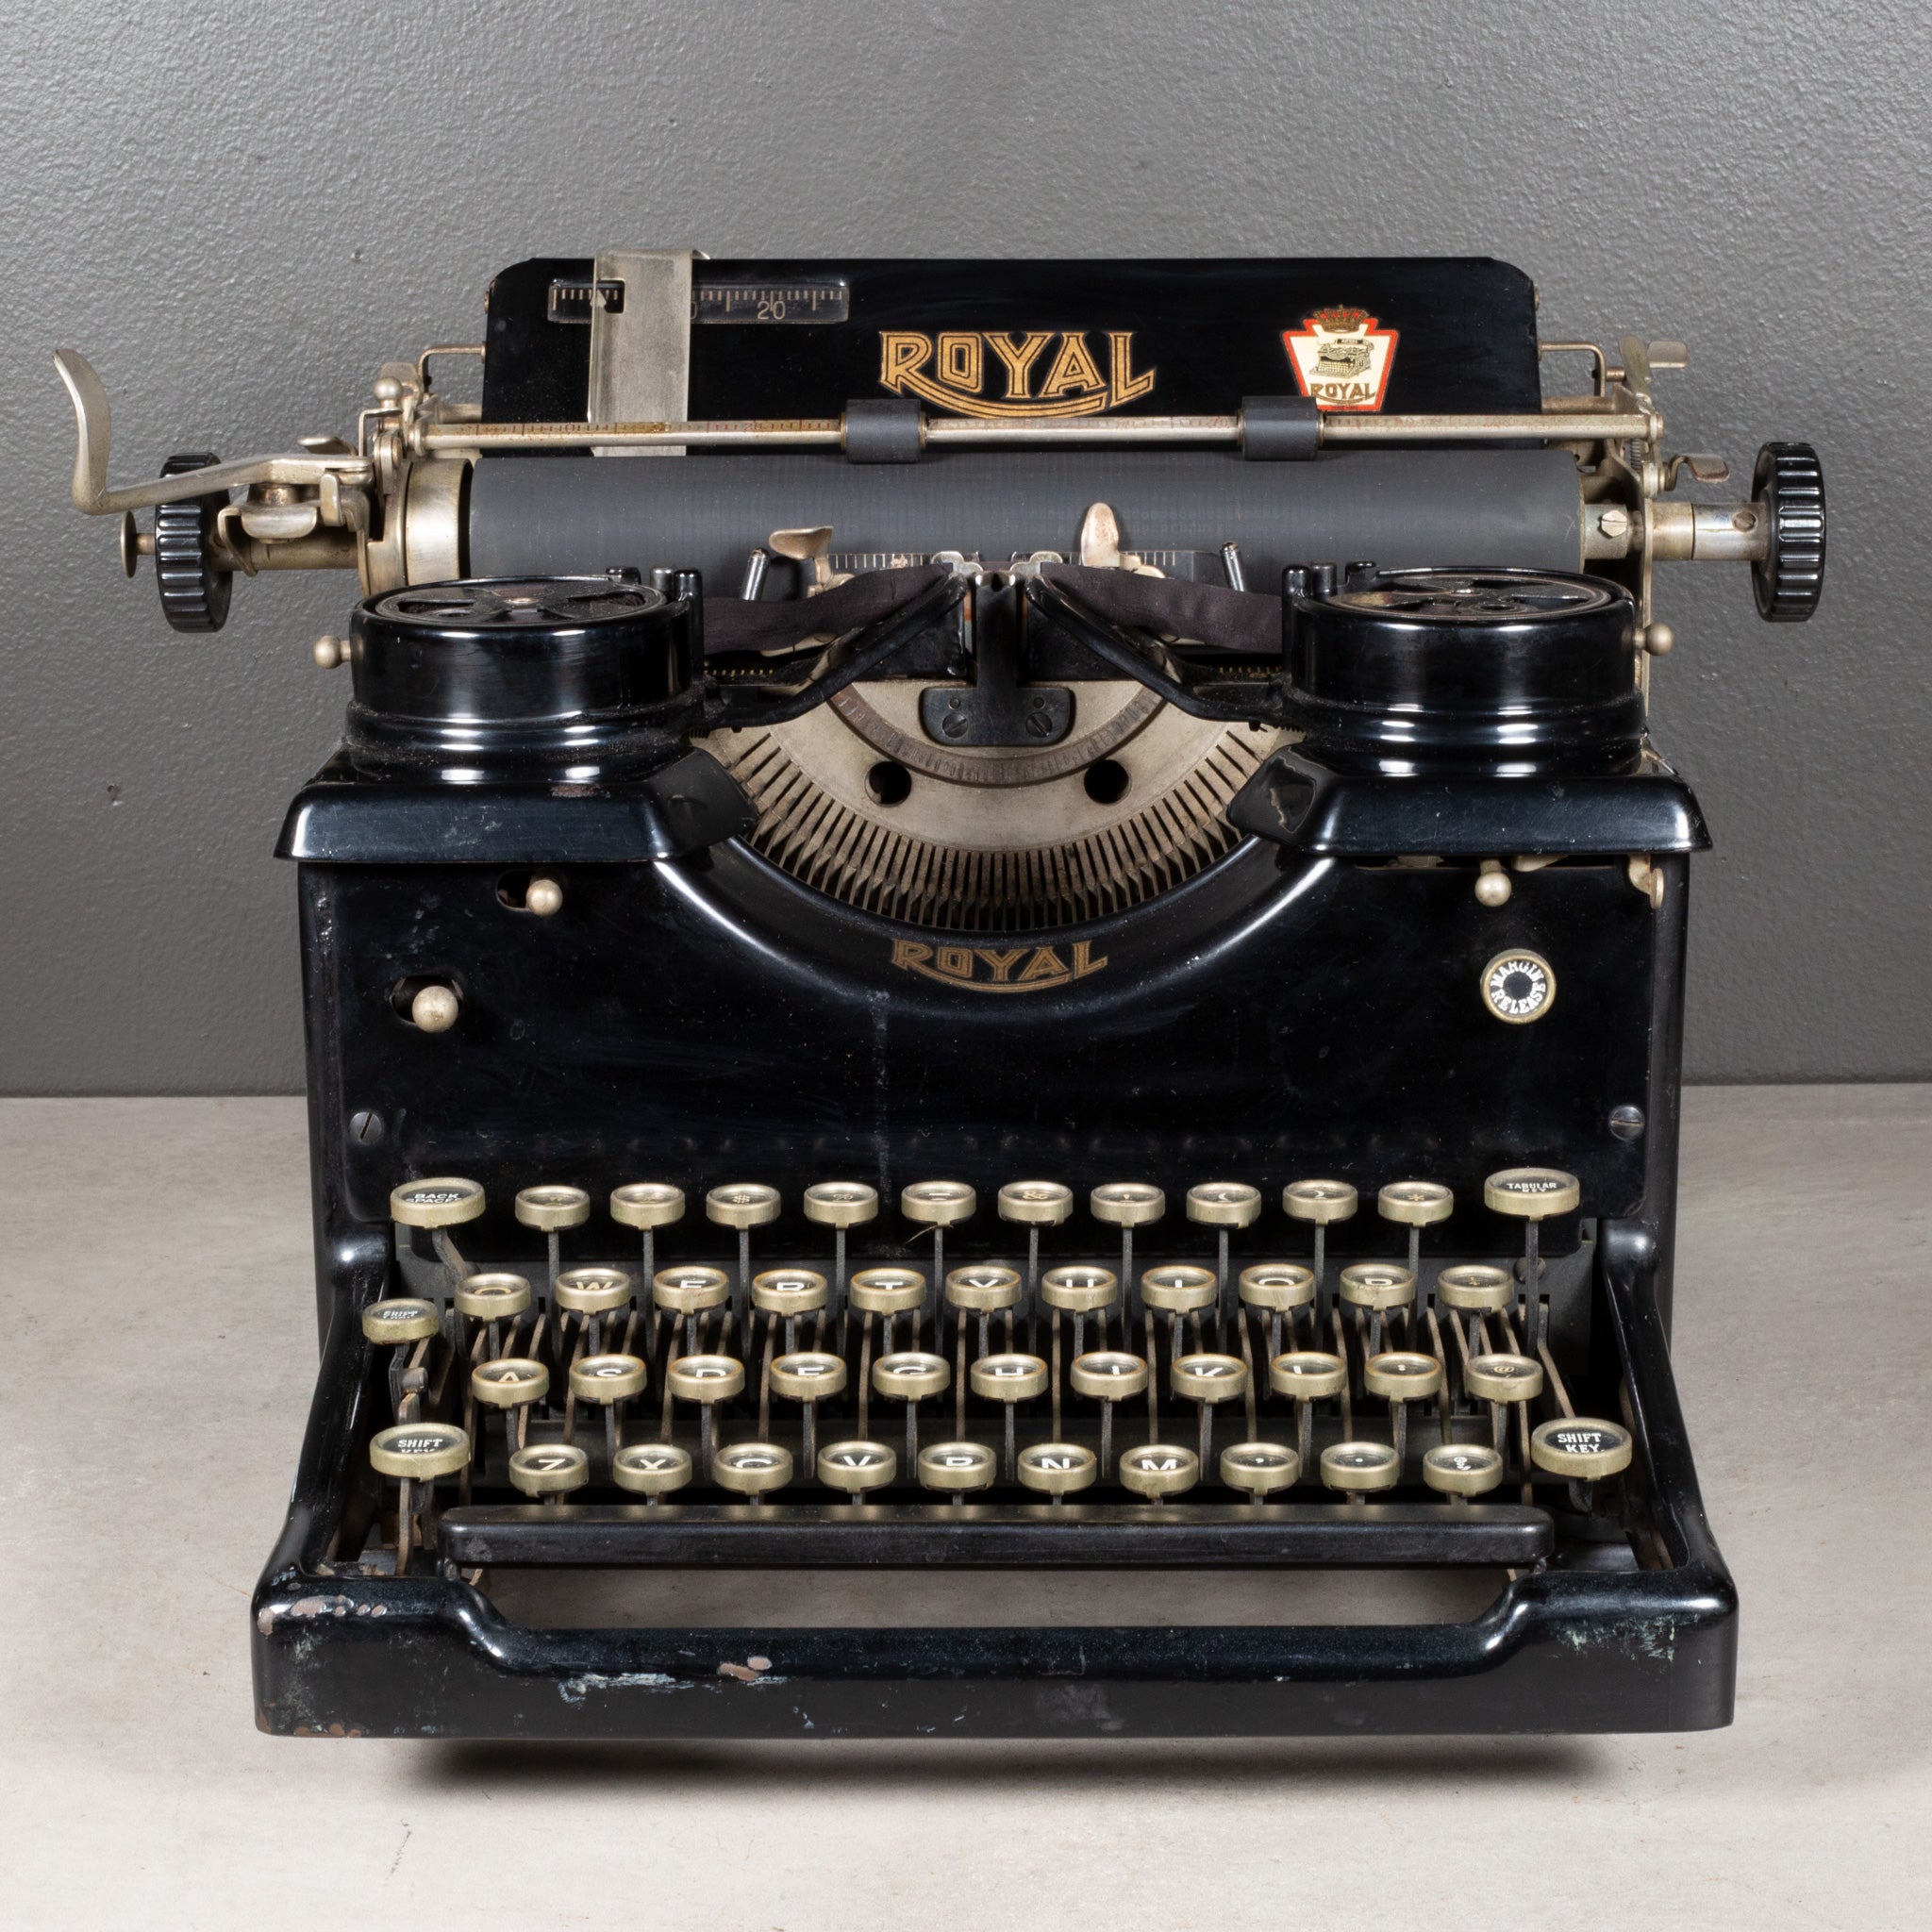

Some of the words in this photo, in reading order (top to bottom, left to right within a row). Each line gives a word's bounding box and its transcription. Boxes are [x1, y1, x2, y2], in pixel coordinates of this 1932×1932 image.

[758, 300, 785, 320] 20
[880, 331, 1156, 418] ROYAL
[1310, 383, 1376, 405] ROYAL
[891, 939, 1108, 993] ROYAL
[1491, 960, 1544, 988] MARGIN
[1491, 982, 1546, 1014] RELEASE
[397, 1439, 443, 1448] SHIFT
[1557, 1433, 1602, 1442] SHIFT
